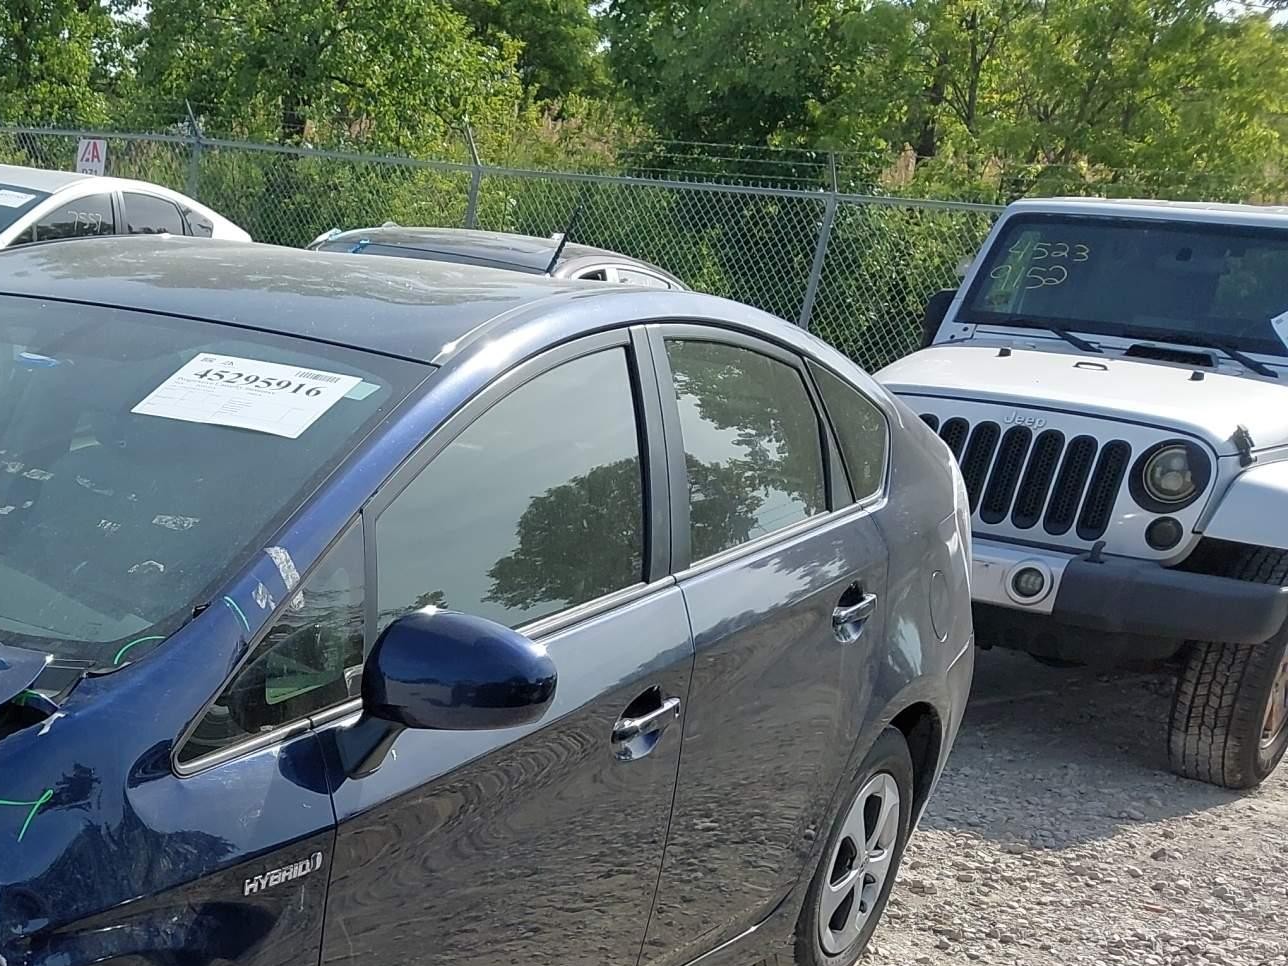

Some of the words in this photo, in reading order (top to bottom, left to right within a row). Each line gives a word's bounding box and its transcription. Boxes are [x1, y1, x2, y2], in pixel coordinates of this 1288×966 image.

[1008, 240, 1090, 262] 4523
[990, 264, 1068, 290] 9152
[193, 368, 327, 398] 45295916
[1004, 410, 1047, 430] Jeep
[243, 857, 312, 897] HYBRID
